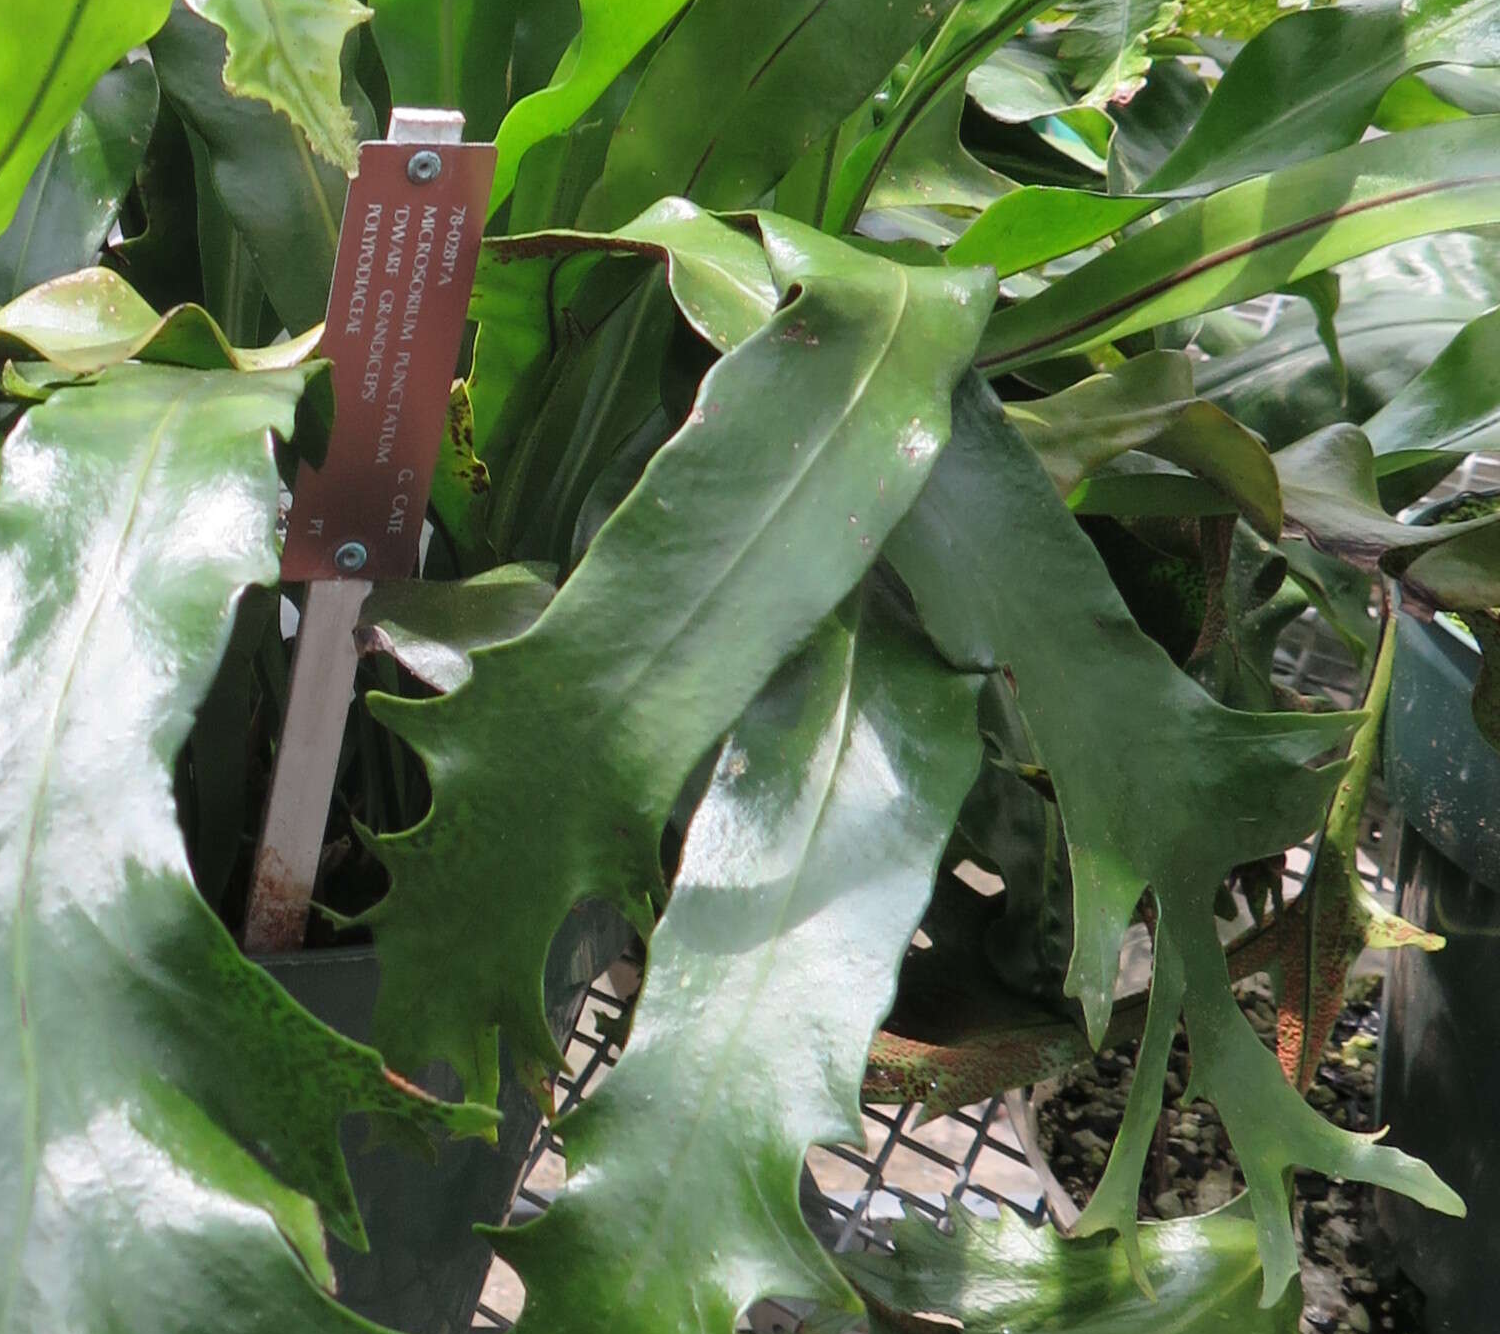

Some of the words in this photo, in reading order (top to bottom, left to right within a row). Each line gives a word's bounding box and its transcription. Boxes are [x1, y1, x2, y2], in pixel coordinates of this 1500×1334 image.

[345, 203, 383, 336] POLYPODIACEAE
[385, 204, 410, 278] 'DWARF
[399, 204, 438, 341] MICROSORIUM
[375, 351, 412, 464] PUNCTATUM
[308, 519, 325, 537] PT
[386, 494, 409, 534] CATE
